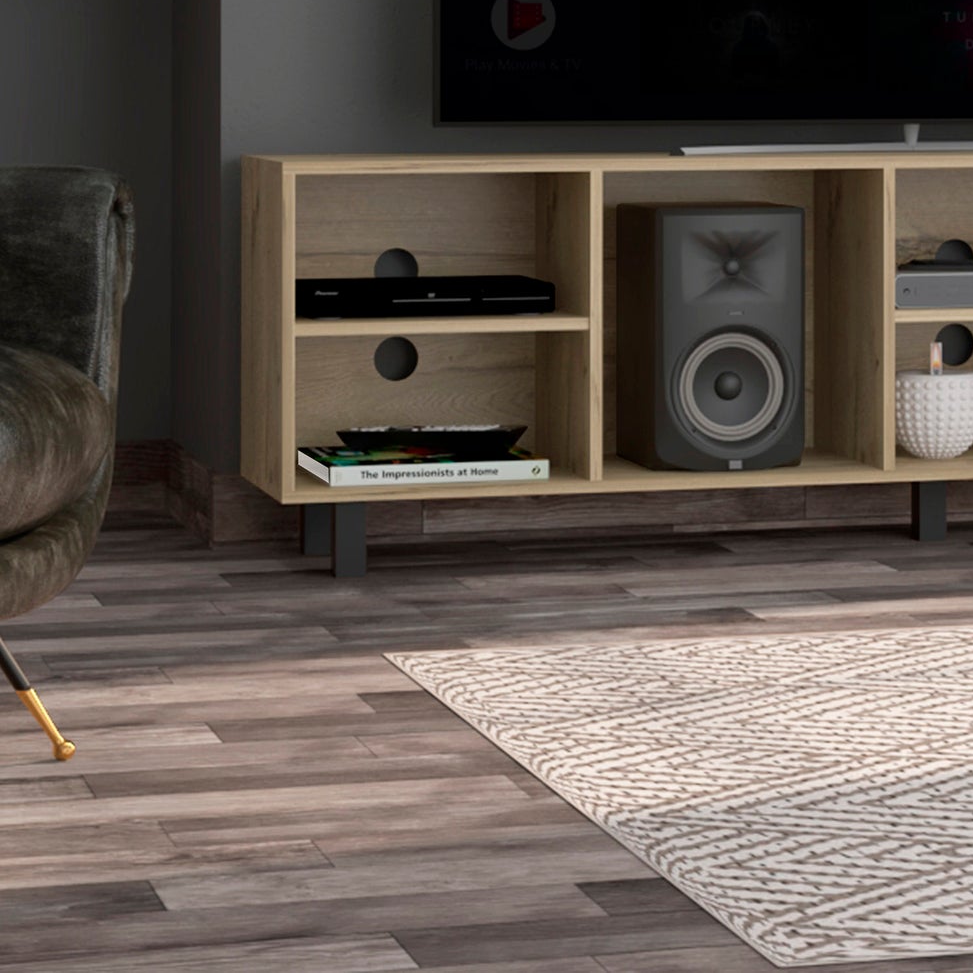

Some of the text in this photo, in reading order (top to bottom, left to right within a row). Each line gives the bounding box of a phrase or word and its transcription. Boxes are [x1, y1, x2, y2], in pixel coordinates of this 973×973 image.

[360, 467, 499, 480] The Impressionists at Home
